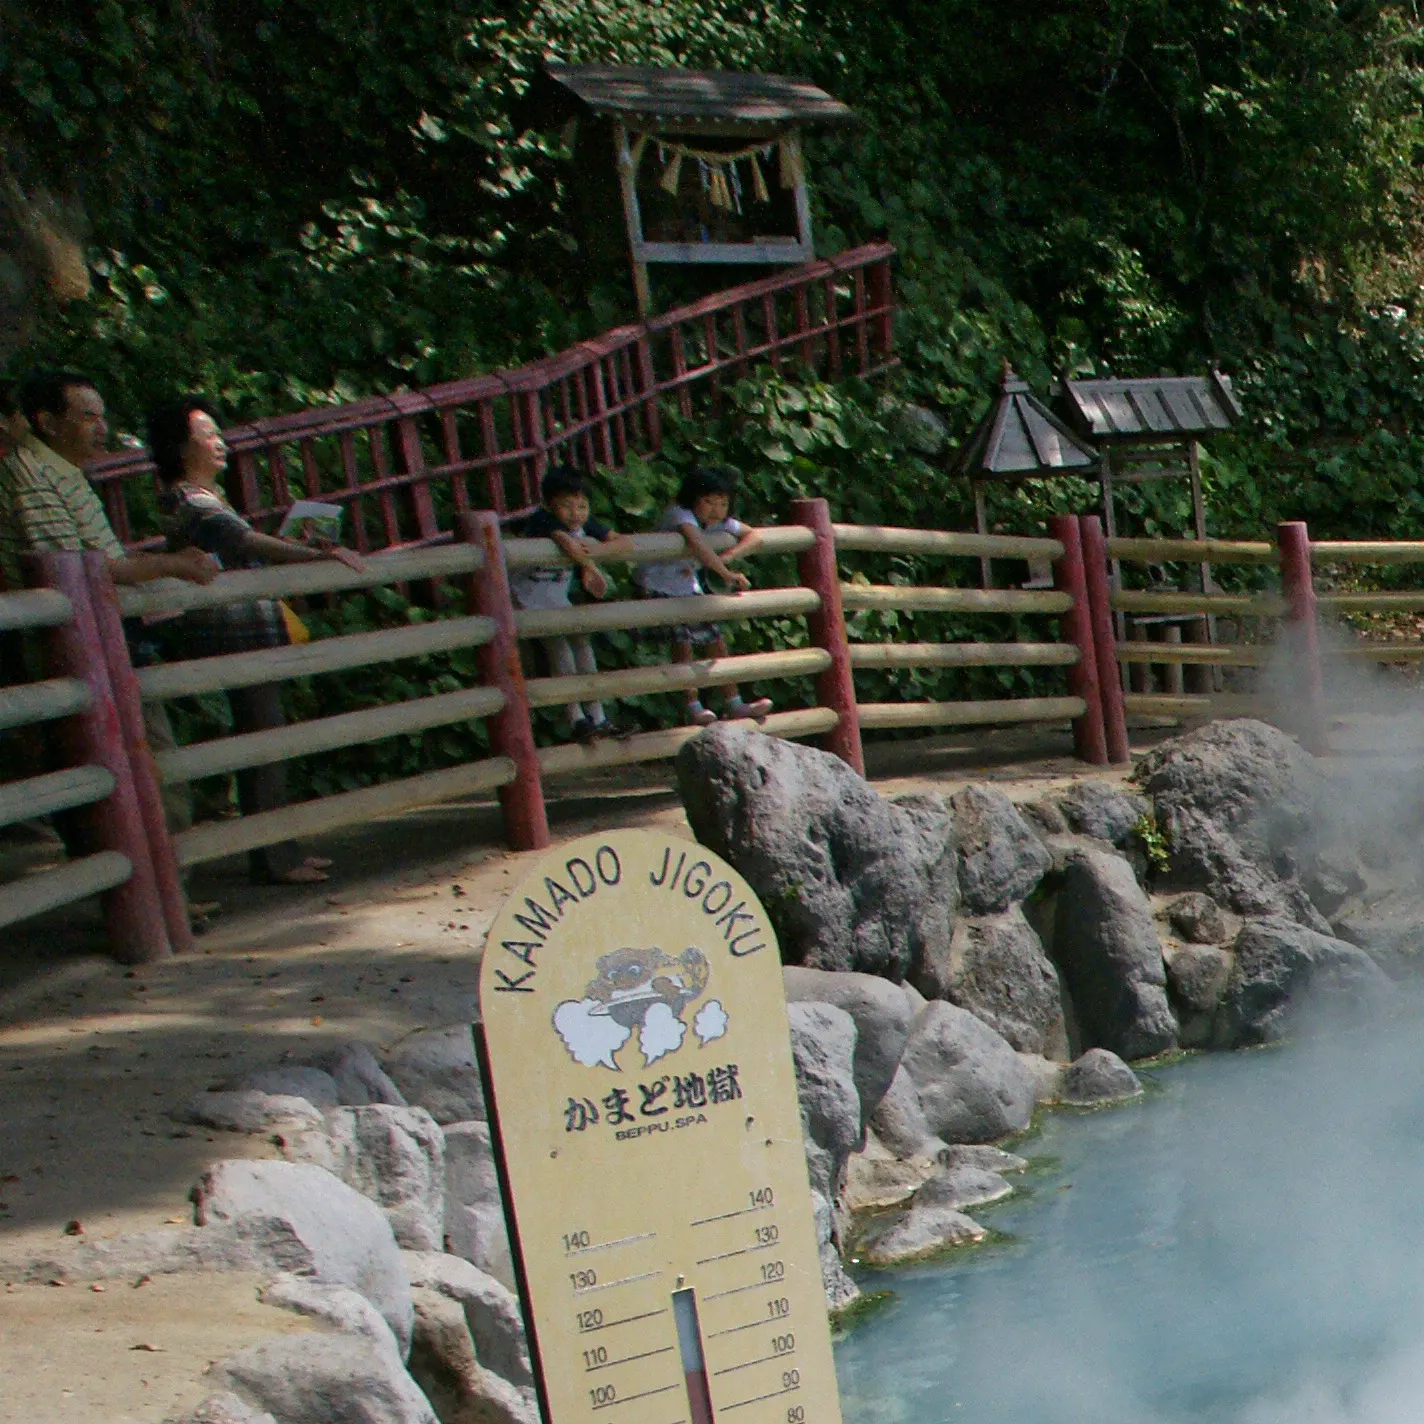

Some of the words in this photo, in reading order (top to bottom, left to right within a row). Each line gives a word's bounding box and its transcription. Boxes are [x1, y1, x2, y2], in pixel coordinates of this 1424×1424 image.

[493, 844, 621, 993] KAMADO
[650, 846, 767, 958] JIGOKU
[563, 1063, 743, 1132] かまど地獄
[615, 1113, 708, 1141] BEPPU.SPA
[749, 1187, 774, 1206] 140
[562, 1231, 591, 1251] 140
[755, 1225, 779, 1243] 130
[569, 1269, 597, 1289] 130
[760, 1261, 785, 1280] 120
[767, 1297, 789, 1316] 110
[576, 1309, 603, 1329] 120
[771, 1333, 795, 1352] 100
[582, 1347, 608, 1367] 110
[782, 1369, 800, 1387] 90
[589, 1384, 616, 1405] 100
[787, 1405, 804, 1424] 80
